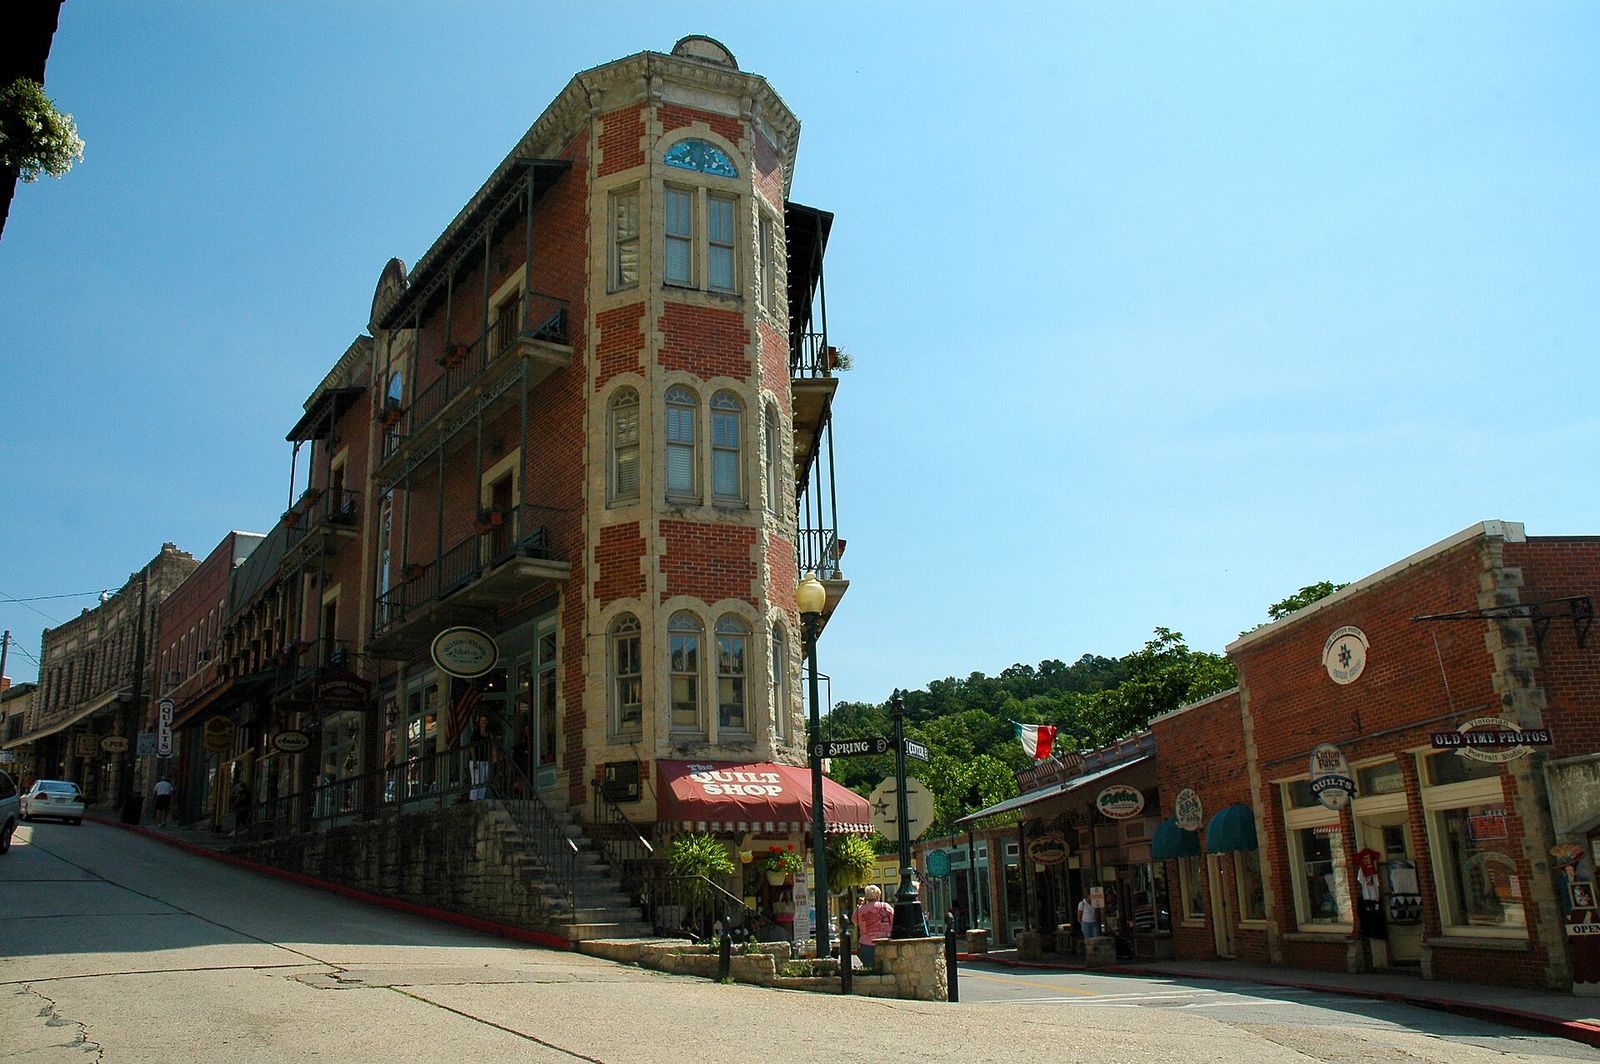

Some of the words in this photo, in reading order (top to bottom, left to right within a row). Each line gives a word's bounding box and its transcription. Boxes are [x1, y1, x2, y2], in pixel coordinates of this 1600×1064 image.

[161, 707, 171, 750] QUILTS
[1468, 718, 1509, 727] Victorian
[110, 740, 123, 748] PUB
[1435, 734, 1461, 745] OLD
[1465, 732, 1496, 744] TIME
[1499, 730, 1549, 744] PHOTOS
[1316, 750, 1340, 760] Cotton
[1467, 748, 1499, 761] Portrait
[1502, 748, 1523, 760] Studio
[687, 764, 714, 773] The
[1318, 759, 1340, 769] Patch
[690, 772, 781, 785] QUILT
[1311, 778, 1353, 792] QUILTS
[703, 784, 783, 797] SHOP
